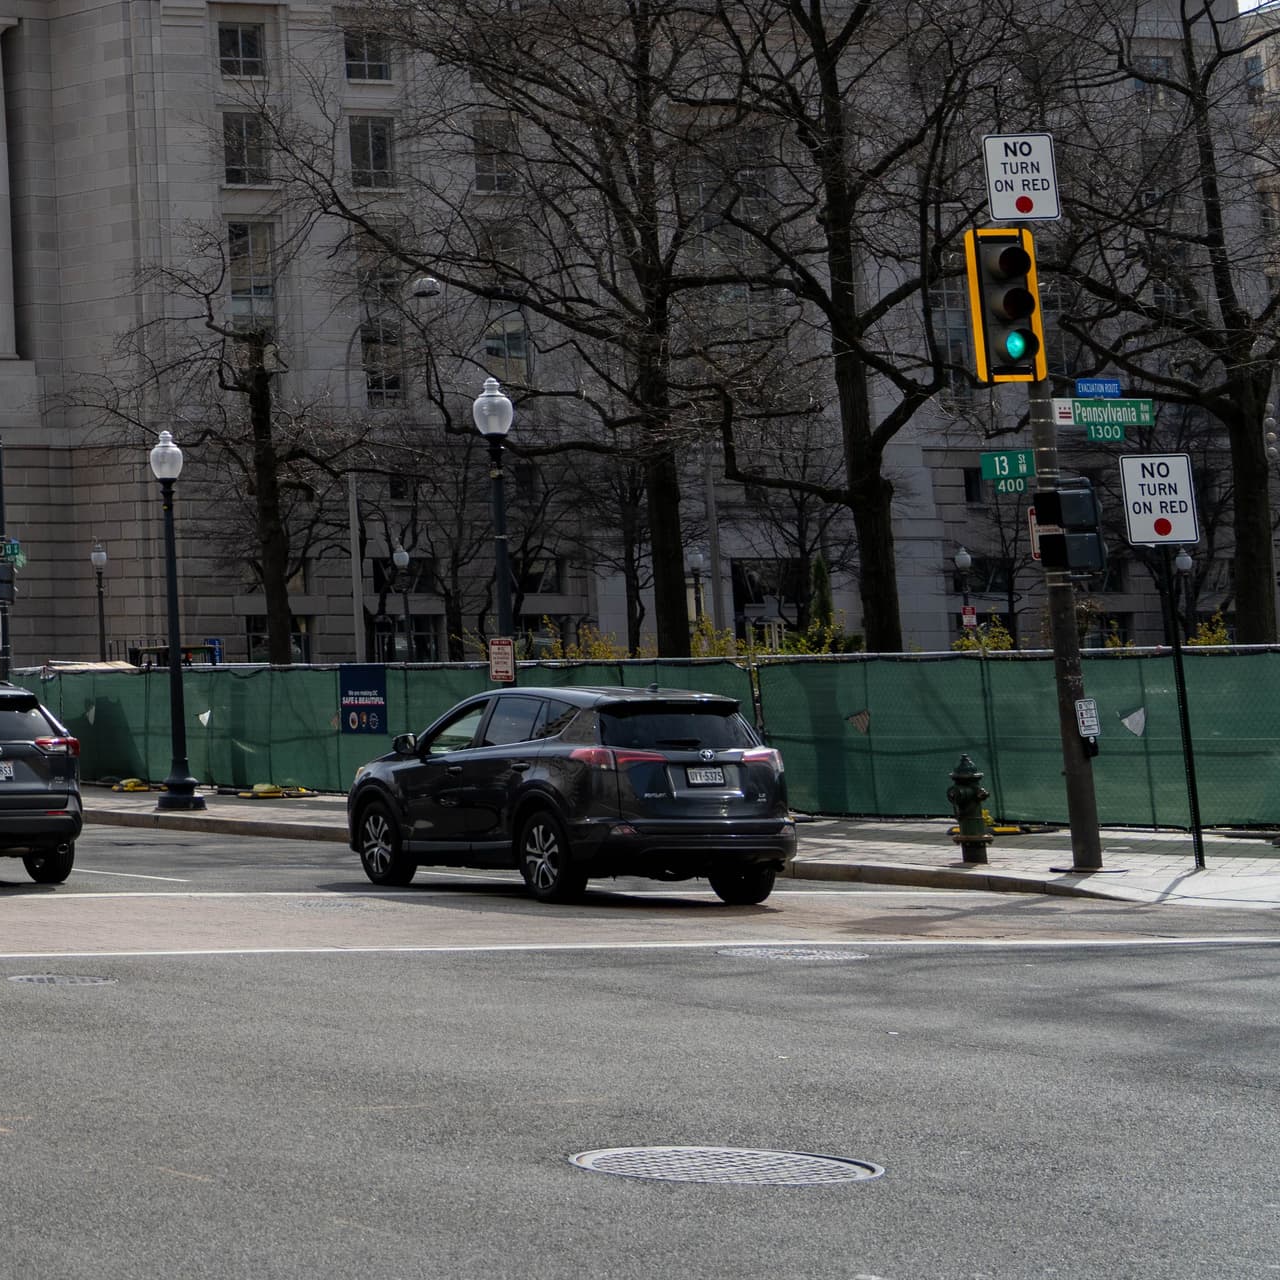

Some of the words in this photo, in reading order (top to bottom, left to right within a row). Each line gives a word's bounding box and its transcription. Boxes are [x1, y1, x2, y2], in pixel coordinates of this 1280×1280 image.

[1003, 141, 1032, 157] NO
[1000, 161, 1040, 175] TURN
[994, 180, 1014, 192] ON
[1022, 179, 1050, 191] RED
[1078, 383, 1105, 393] EVACUATION
[1105, 383, 1119, 393] ROUTE
[1074, 401, 1137, 423] Pennsylvania
[1090, 425, 1121, 439] 1300
[994, 455, 1009, 476] 13
[1017, 454, 1026, 464] St
[1141, 462, 1170, 479] NO
[998, 478, 1024, 492] 400
[1138, 482, 1178, 496] TURN
[1132, 501, 1153, 515] ON
[1160, 500, 1188, 514] RED
[342, 696, 354, 704] SAFE
[358, 696, 385, 704] BEAUTIFUL
